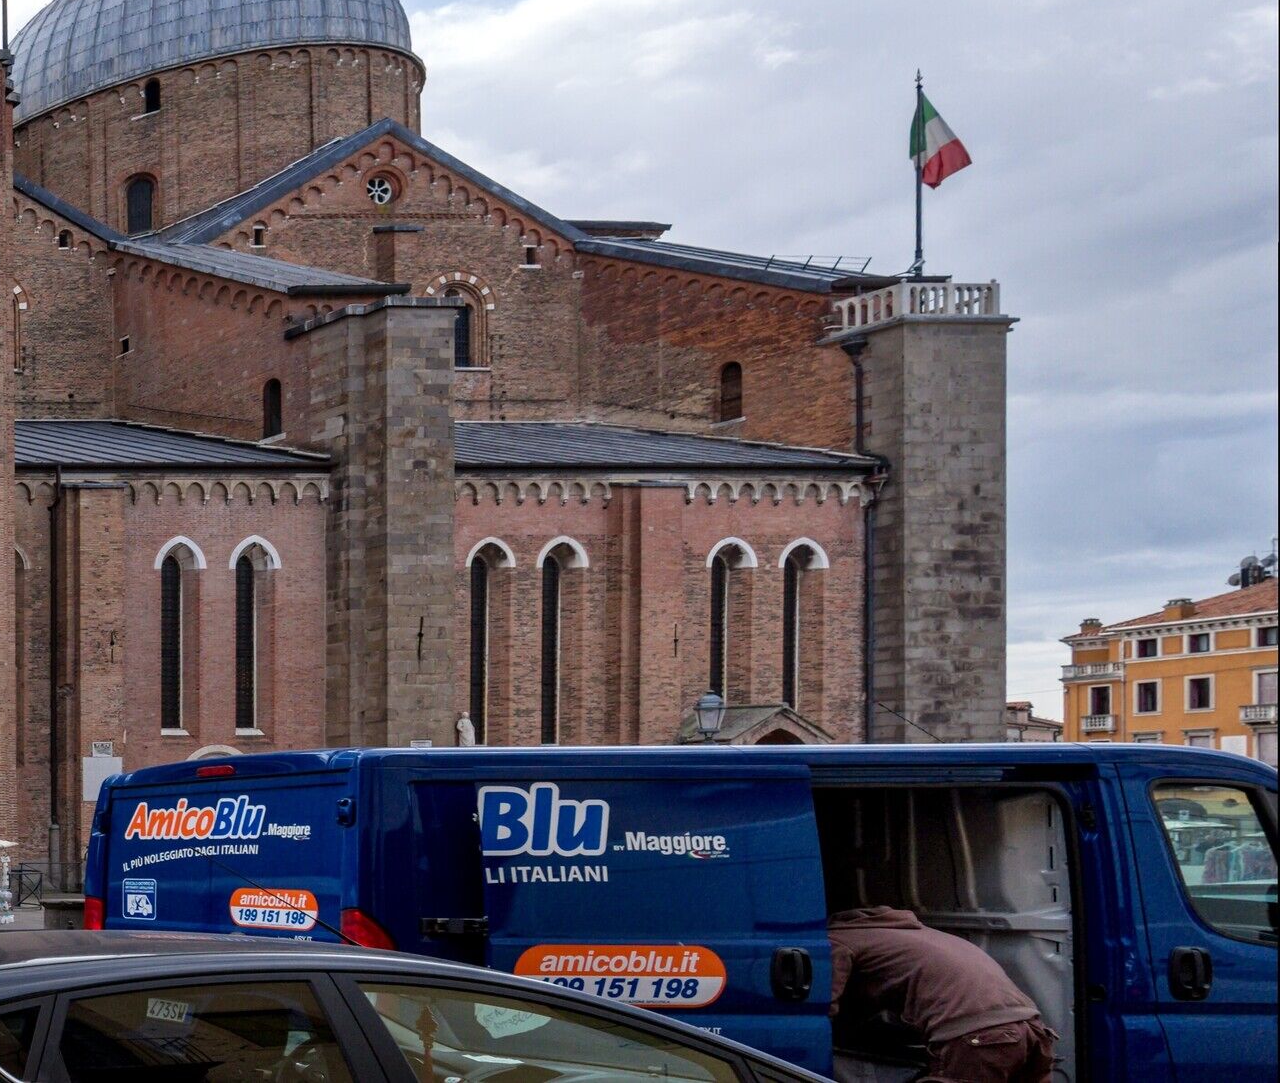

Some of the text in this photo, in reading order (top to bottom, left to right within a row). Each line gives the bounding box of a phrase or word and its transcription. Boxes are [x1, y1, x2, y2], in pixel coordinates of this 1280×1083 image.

[125, 795, 266, 840] AmicoBlu
[478, 782, 610, 857] Blu
[267, 823, 311, 838] Maggiore
[625, 832, 726, 855] Maggiore
[123, 844, 259, 872] IL PIÙ NOLEGGIATO DAGLI ITALIANI
[512, 865, 609, 883] ITALIANI
[240, 892, 307, 908] amicoblu.it
[239, 909, 305, 924] 199 151 198
[540, 950, 700, 973] amicoblu.it
[594, 978, 640, 998] 151
[652, 978, 699, 999] 198
